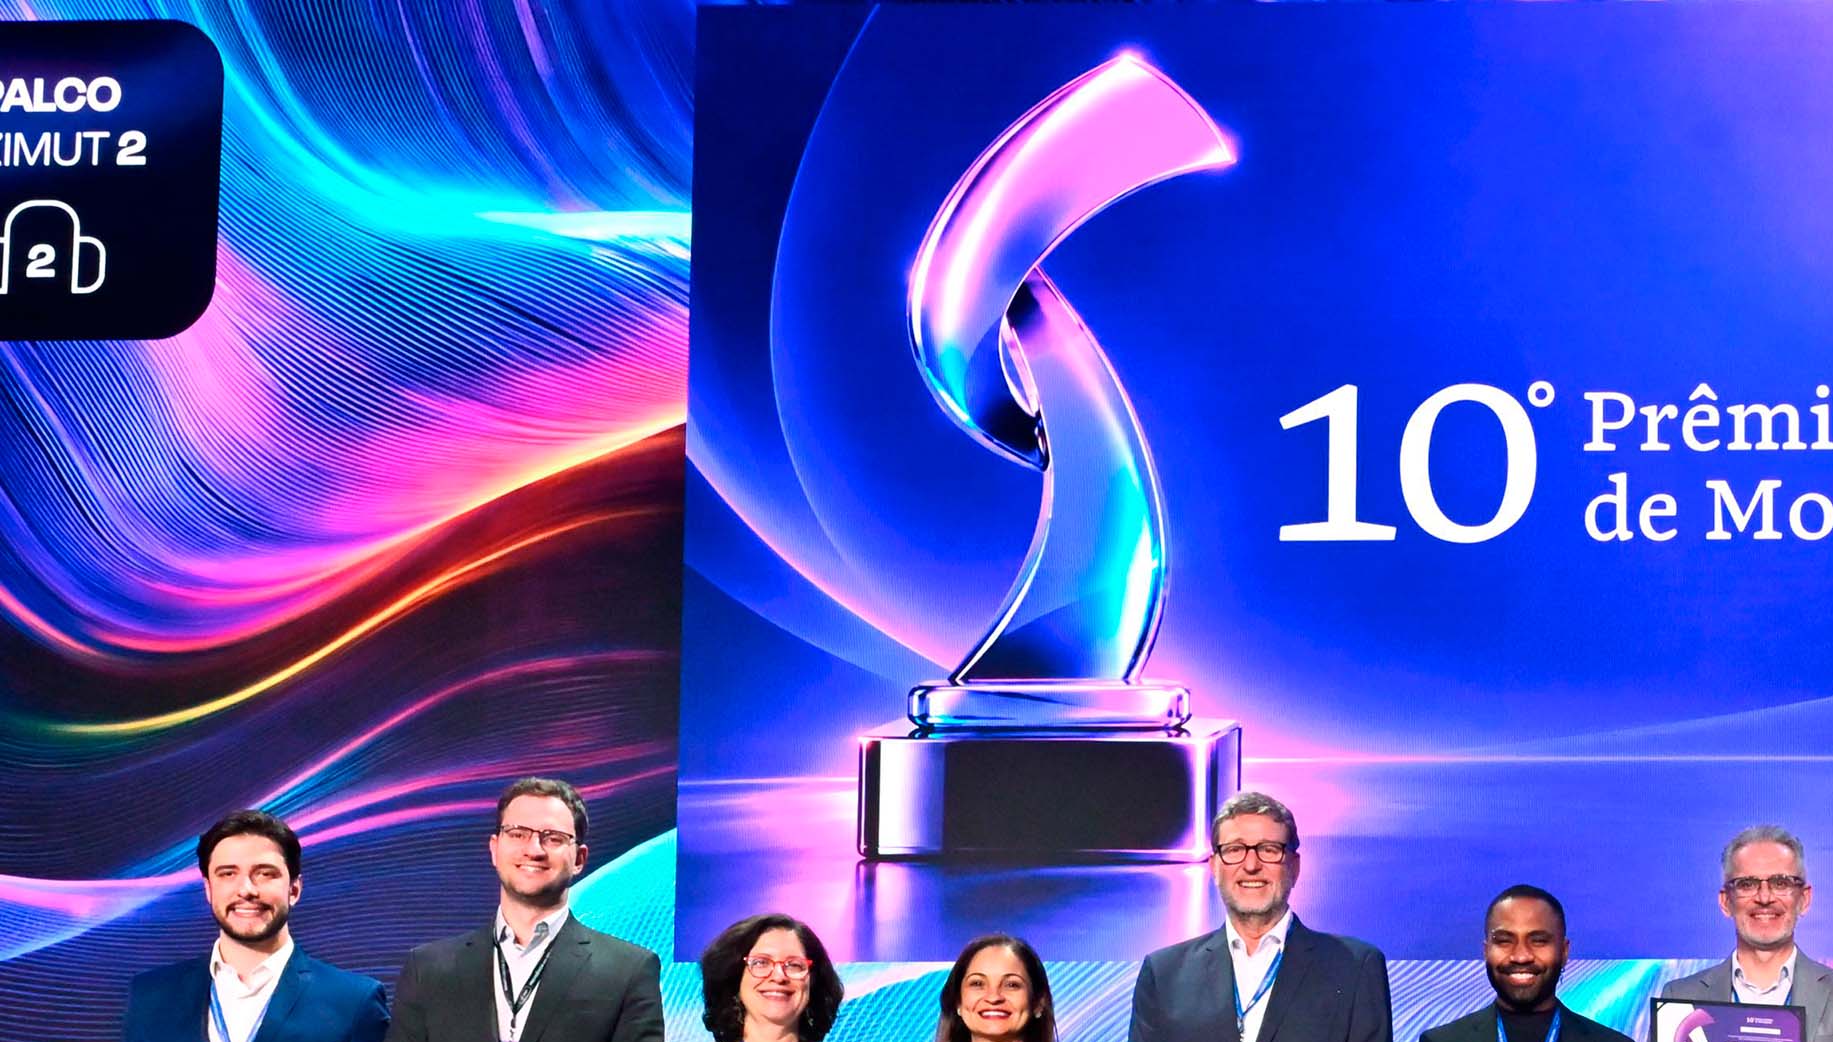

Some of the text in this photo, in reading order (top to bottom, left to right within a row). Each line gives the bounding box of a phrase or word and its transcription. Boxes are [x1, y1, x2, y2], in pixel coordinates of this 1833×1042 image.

[0, 77, 122, 112] ALCO
[0, 130, 147, 166] IMUT 2
[25, 243, 56, 278] 2
[1584, 471, 1679, 542] de
